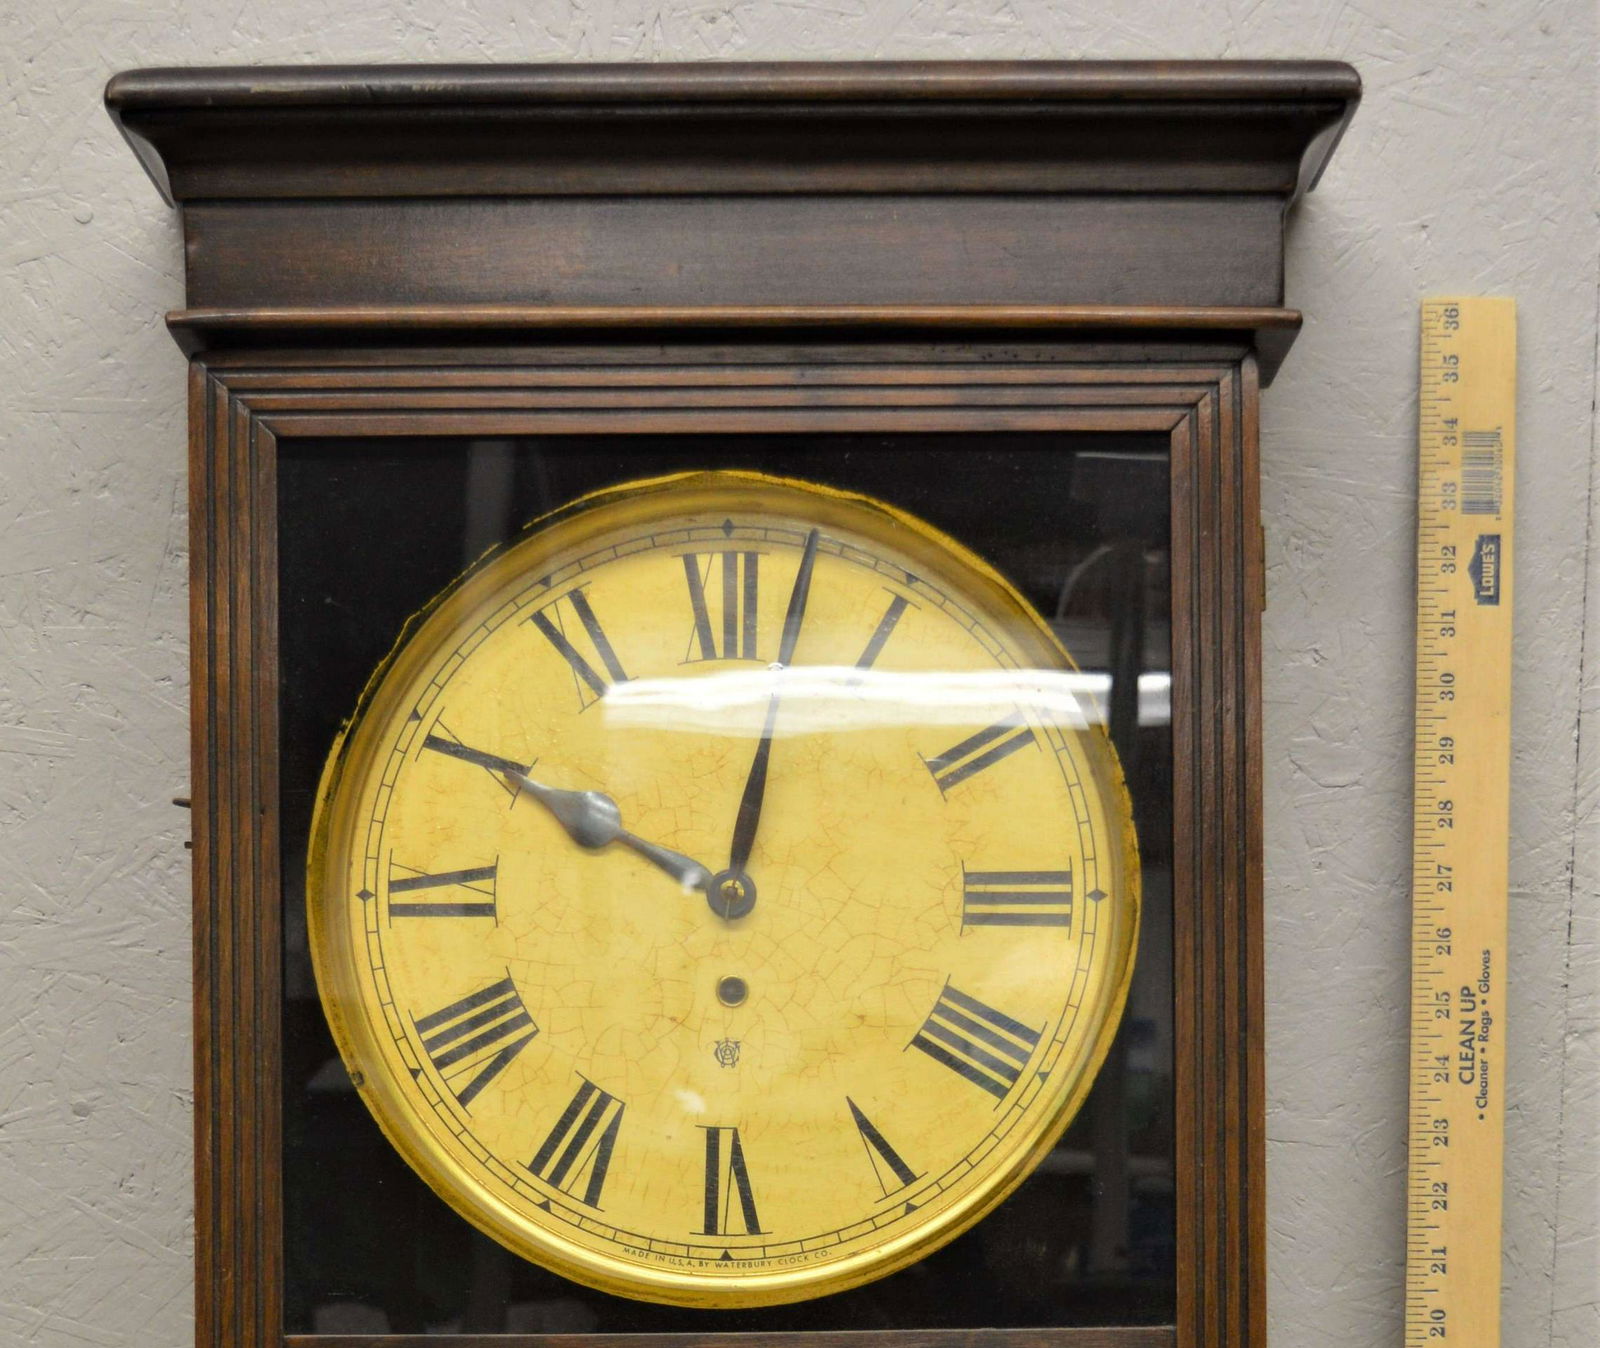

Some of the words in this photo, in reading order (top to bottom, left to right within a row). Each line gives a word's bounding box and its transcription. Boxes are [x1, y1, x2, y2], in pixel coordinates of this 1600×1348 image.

[1444, 308, 1459, 330] 36
[1443, 355, 1459, 383] 35
[1443, 418, 1458, 446] 34
[1442, 482, 1457, 510] 33
[1441, 546, 1456, 574] 32
[1479, 544, 1495, 596] LOWE'S
[1440, 610, 1455, 637] 31
[1439, 673, 1454, 701] 30
[1439, 736, 1454, 765] 29
[1438, 800, 1453, 829] 28
[1437, 864, 1452, 892] 27
[1436, 928, 1451, 956] 26
[1478, 950, 1491, 994] Gloves
[1435, 991, 1451, 1019] 25
[1461, 986, 1476, 1012] UP
[1478, 1011, 1493, 1042] Rags
[1459, 1020, 1474, 1084] CLEAN
[1434, 1055, 1449, 1083] 24
[1477, 1060, 1490, 1109] Cleaner
[1433, 1119, 1449, 1147] 23
[1432, 1182, 1448, 1211] 22
[623, 1247, 649, 1260] MADE
[669, 1258, 696, 1266] U.S.A.
[715, 1260, 772, 1269] WATERBURY
[778, 1255, 809, 1265] CLOCK
[814, 1250, 832, 1259] CO.
[1431, 1247, 1447, 1274] 21
[1430, 1310, 1446, 1337] 20
